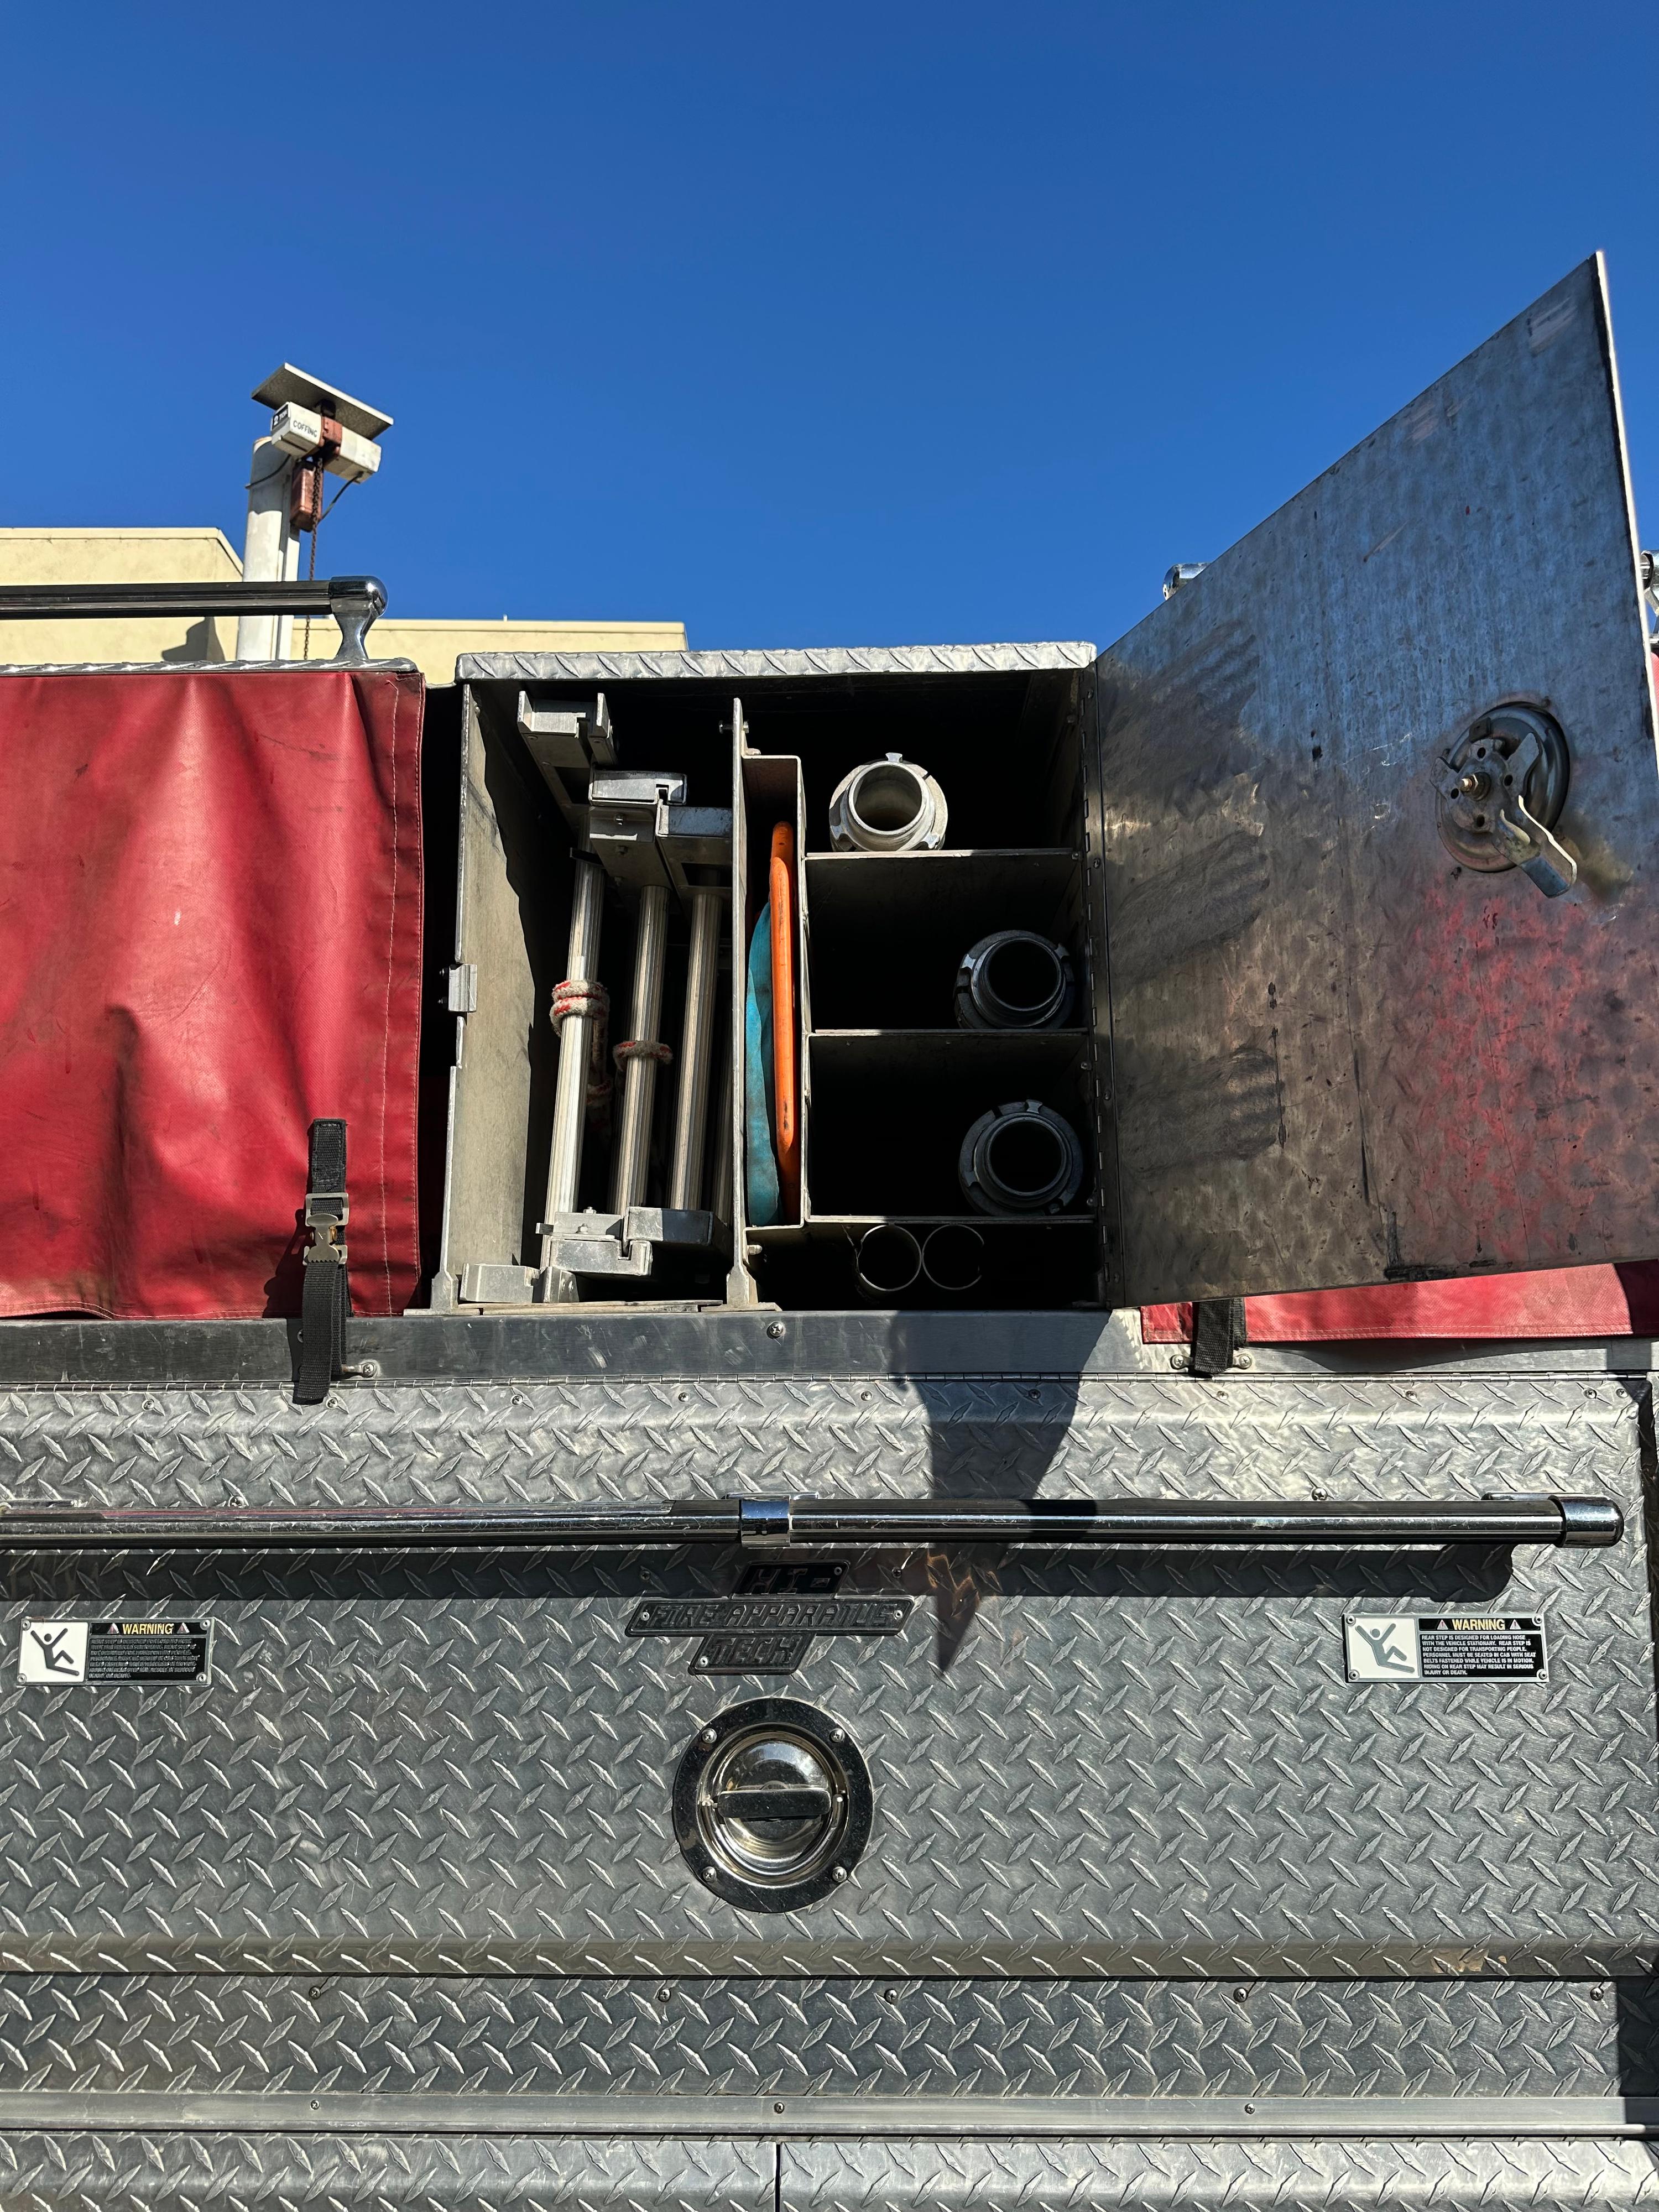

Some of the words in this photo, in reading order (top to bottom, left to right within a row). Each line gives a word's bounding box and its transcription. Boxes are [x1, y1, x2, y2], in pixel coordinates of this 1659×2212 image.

[293, 420, 317, 437] COFFING
[653, 1605, 718, 1627] FIRE
[723, 1603, 898, 1627] APPARATUS
[122, 1623, 174, 1635] WARNING
[1452, 1619, 1505, 1630] WARNING
[711, 1637, 802, 1665] TECH
